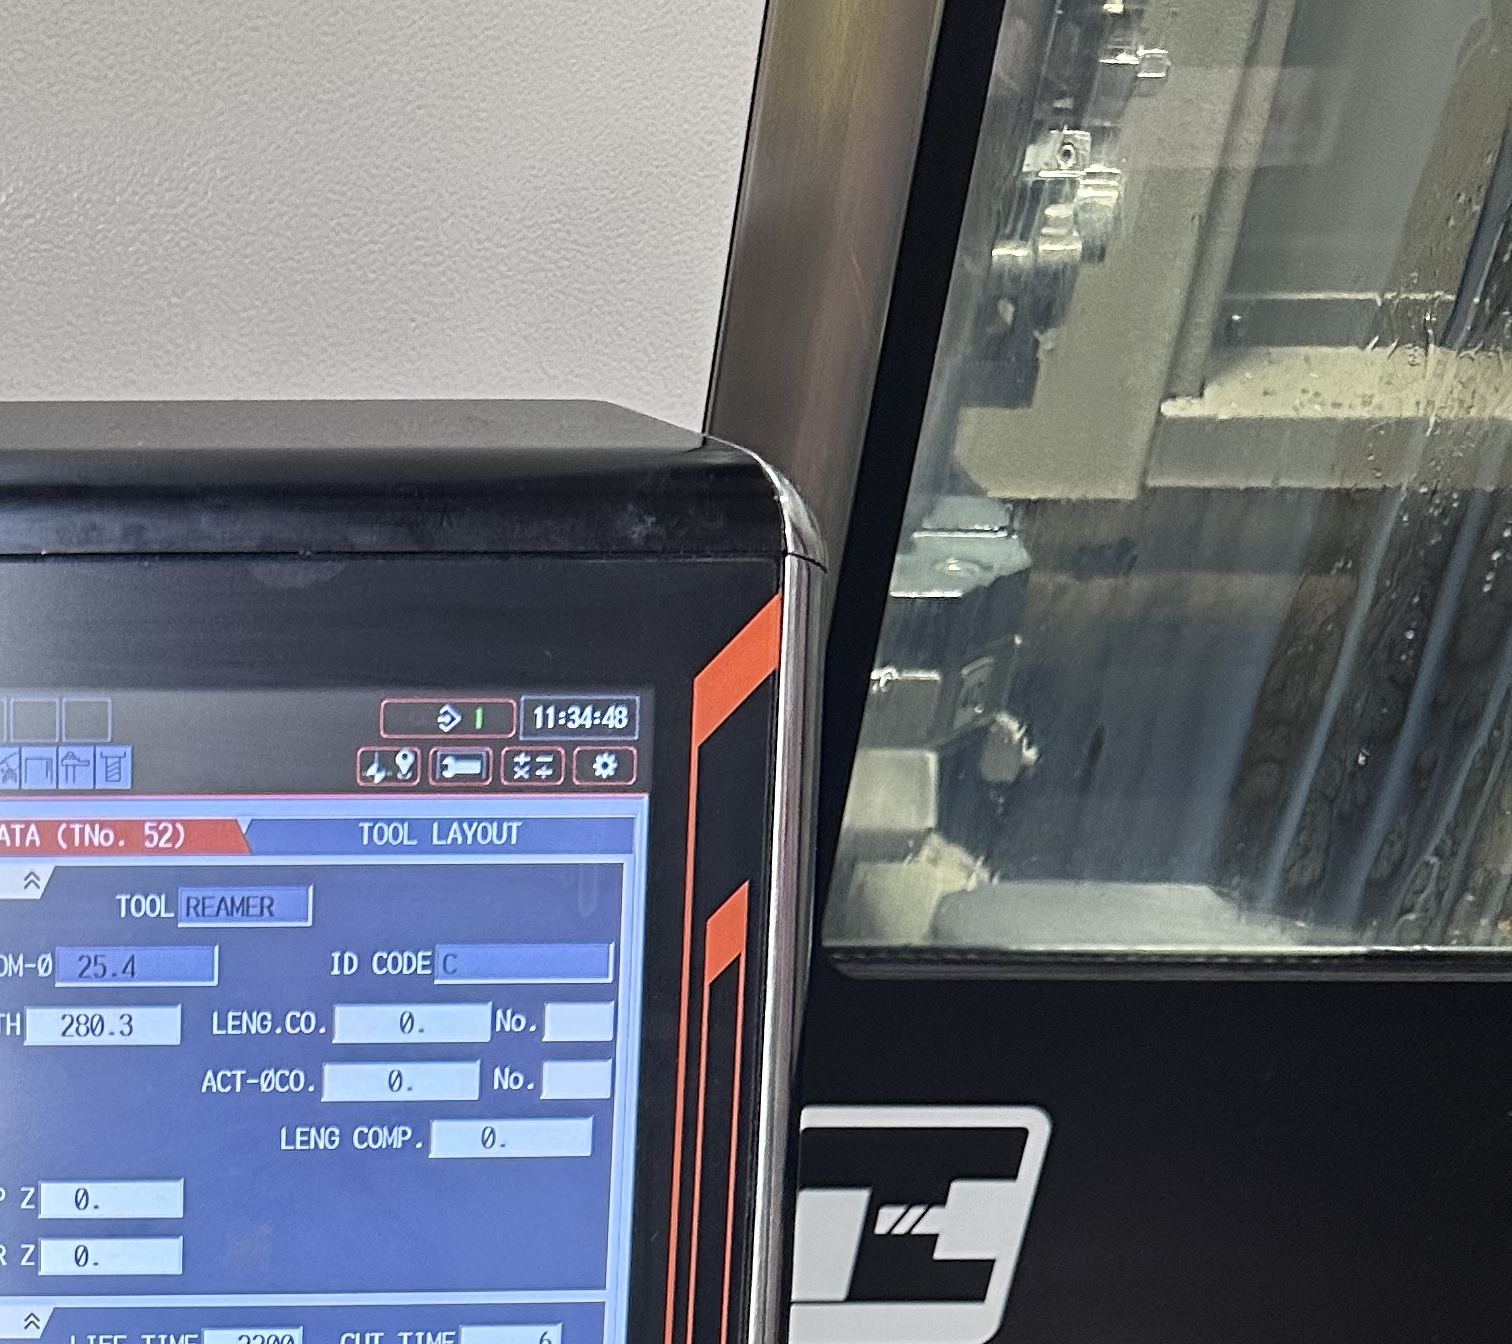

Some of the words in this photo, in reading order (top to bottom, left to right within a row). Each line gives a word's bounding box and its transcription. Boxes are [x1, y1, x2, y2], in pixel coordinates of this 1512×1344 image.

[533, 705, 629, 729] 11:34:48
[57, 824, 125, 849] (TNo.
[144, 822, 186, 849] 52)
[359, 821, 418, 846] TOOL
[432, 820, 522, 845] LAYOUT
[116, 894, 175, 918] TOOL
[187, 896, 272, 917] REAMER
[77, 955, 136, 979] 25.4
[330, 951, 358, 976] ID
[372, 951, 433, 976] CODE
[61, 1014, 134, 1038] 280.3
[496, 1009, 537, 1033] No.
[493, 1067, 535, 1090] No.
[280, 1127, 339, 1150] LENG
[353, 1126, 423, 1149] COMP.
[20, 1188, 35, 1209] Z
[20, 1245, 35, 1266] Z
